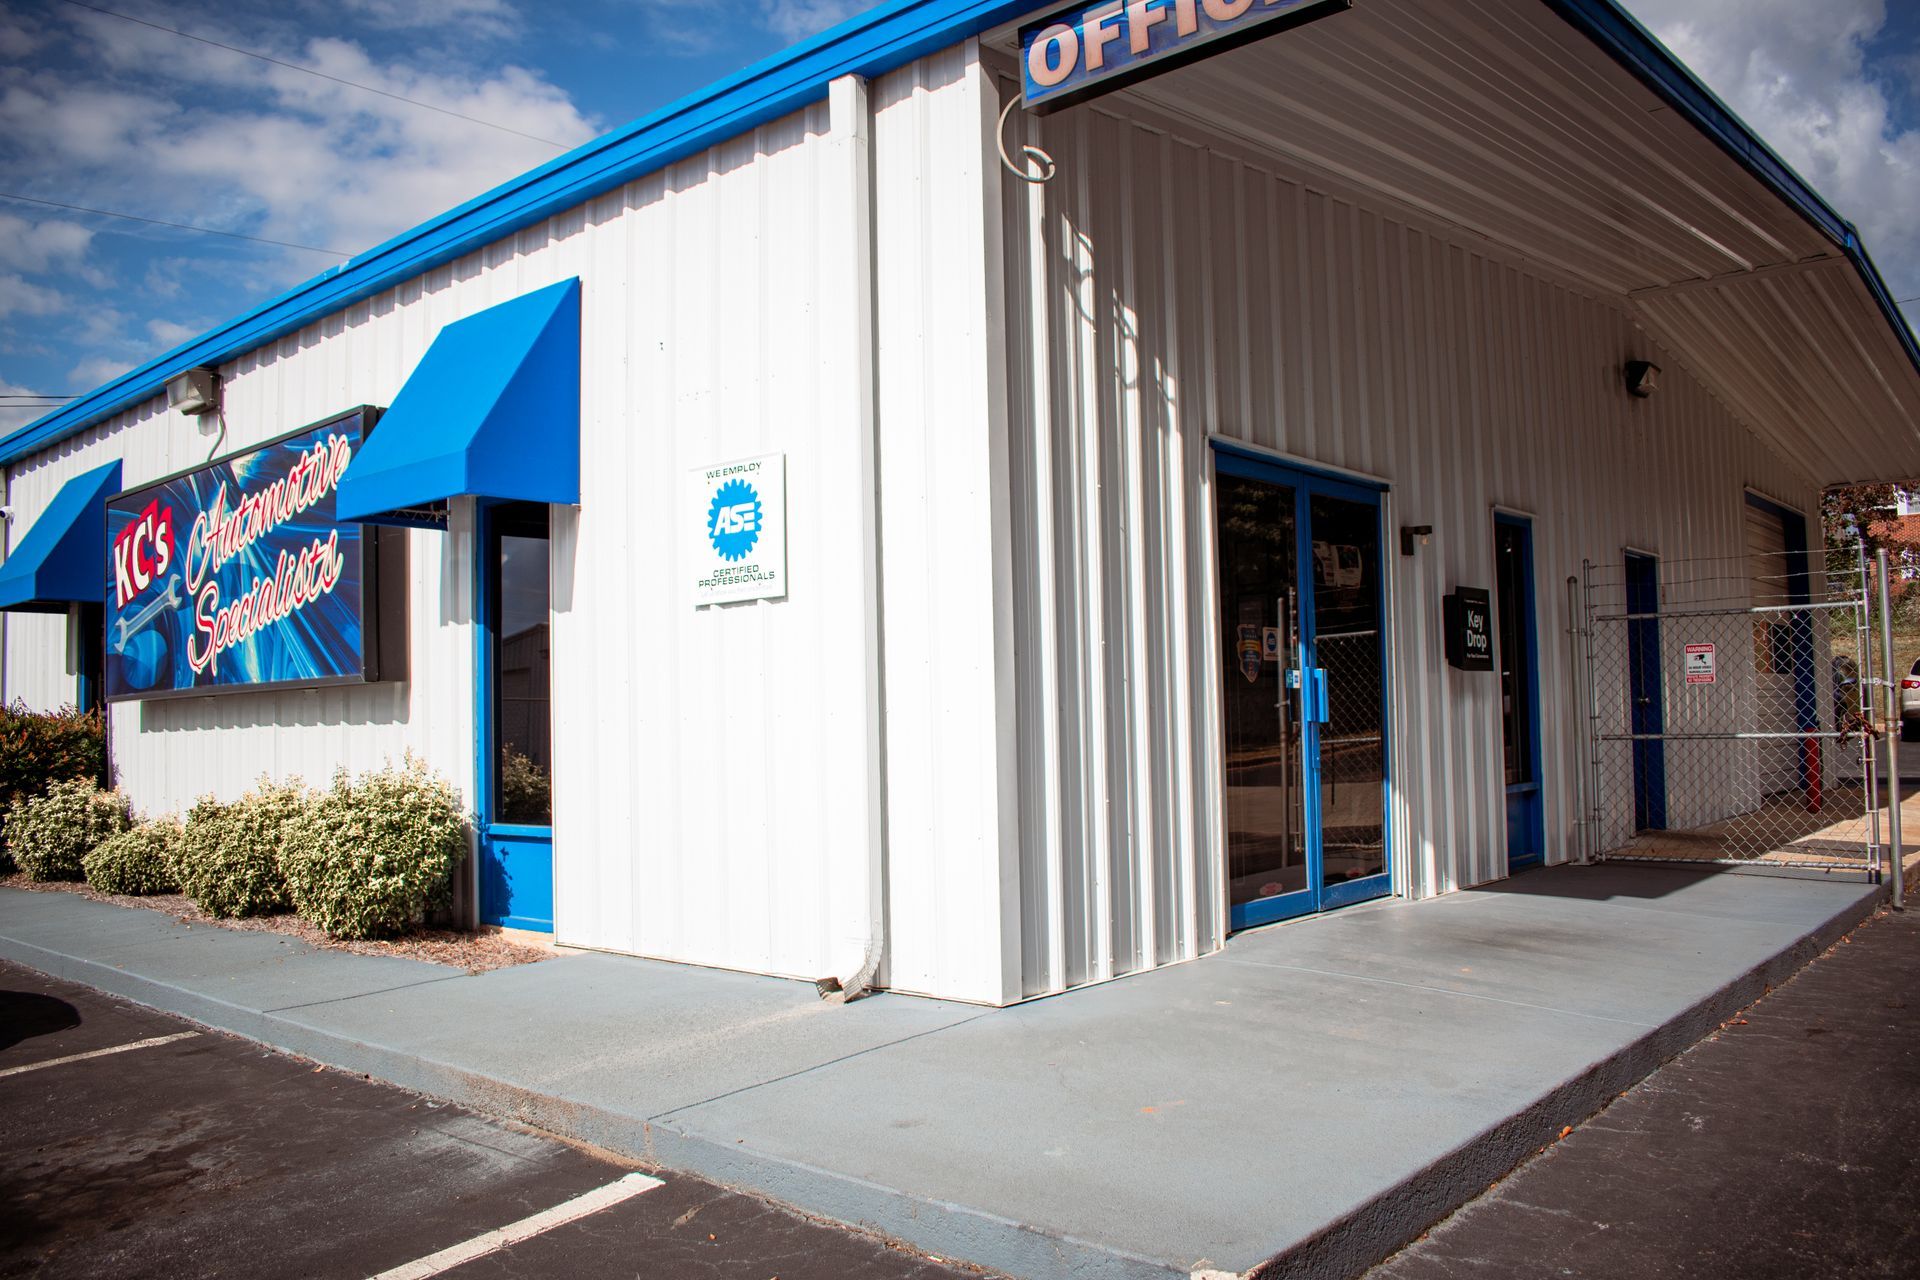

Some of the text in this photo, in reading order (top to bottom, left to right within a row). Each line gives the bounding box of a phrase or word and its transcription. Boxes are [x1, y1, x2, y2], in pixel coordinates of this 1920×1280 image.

[1028, 0, 1280, 87] OFFI
[706, 462, 762, 479] WE EMPLOY
[186, 433, 351, 595] Automotive
[713, 502, 755, 537] ASE
[114, 511, 170, 609] KC's
[713, 564, 760, 578] CERTIFIED
[698, 571, 775, 588] PROFESSIONALS
[187, 529, 344, 676] Specialists
[1467, 609, 1484, 632] Key
[1466, 629, 1487, 652] Drop
